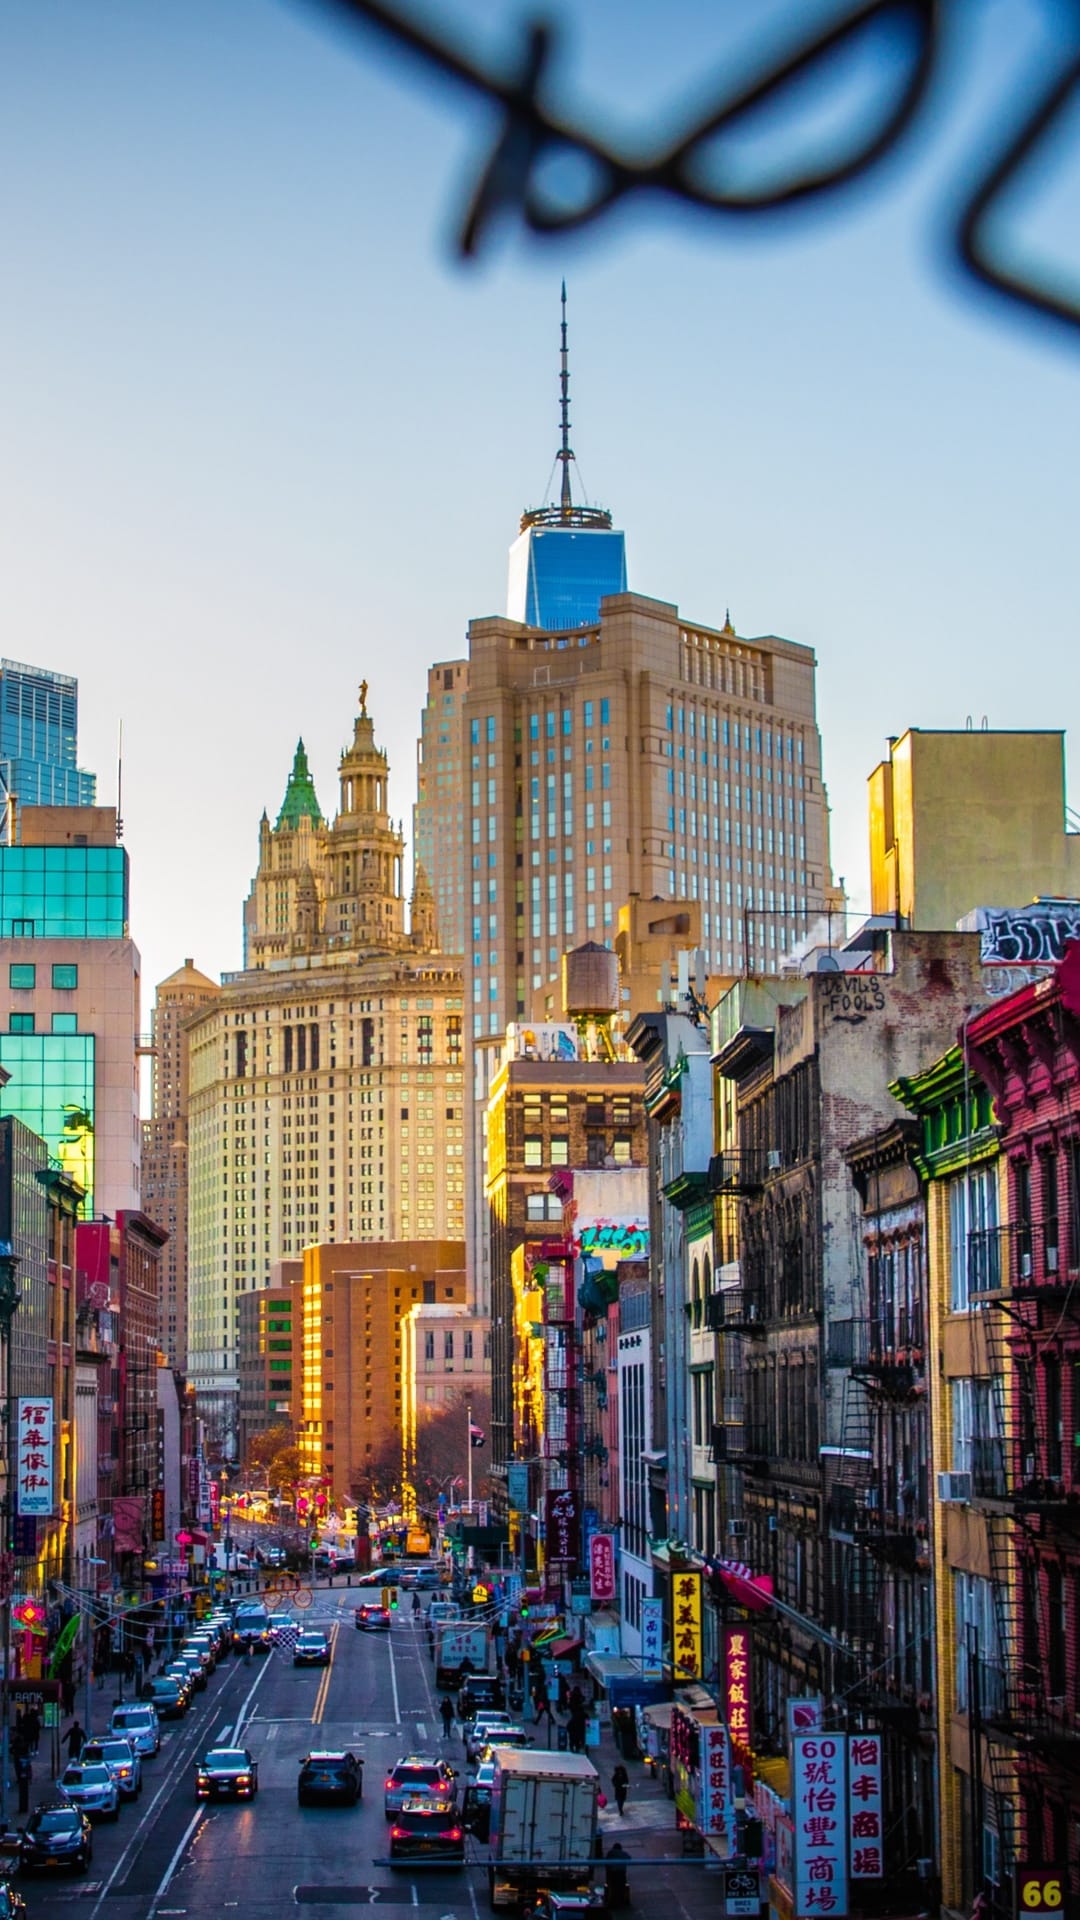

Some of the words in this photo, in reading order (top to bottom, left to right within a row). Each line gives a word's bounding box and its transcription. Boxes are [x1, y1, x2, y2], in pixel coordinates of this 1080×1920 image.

[830, 991, 885, 1011] FOOLS
[20, 1405, 50, 1494] 福華傢俬
[675, 1577, 699, 1677] 華美商場
[727, 1634, 748, 1730] 農家飯莊
[708, 1731, 727, 1833] 興旺旺商場
[1022, 1880, 1062, 1908] 66
